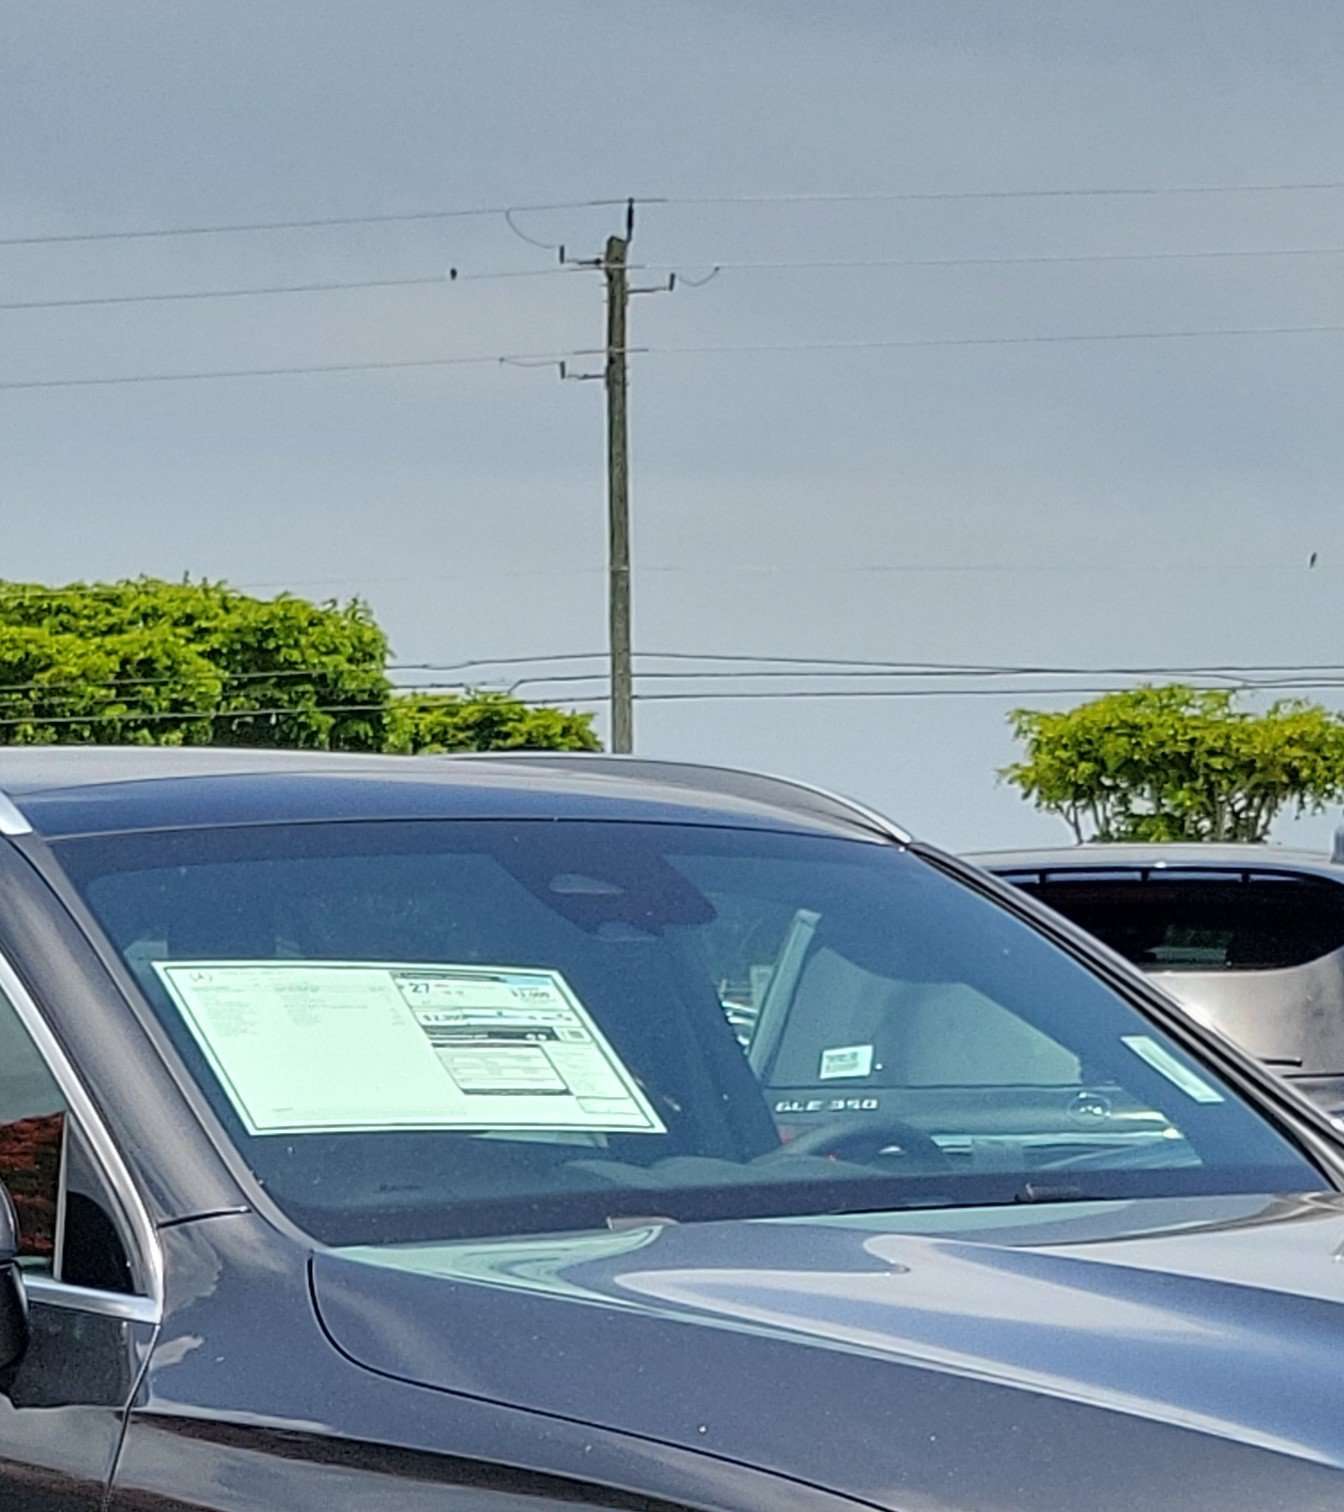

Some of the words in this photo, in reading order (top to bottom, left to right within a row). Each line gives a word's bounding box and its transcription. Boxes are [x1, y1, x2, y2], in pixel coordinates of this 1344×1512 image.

[408, 982, 430, 994] 27
[775, 1100, 823, 1112] GLE
[829, 1098, 878, 1111] 350
